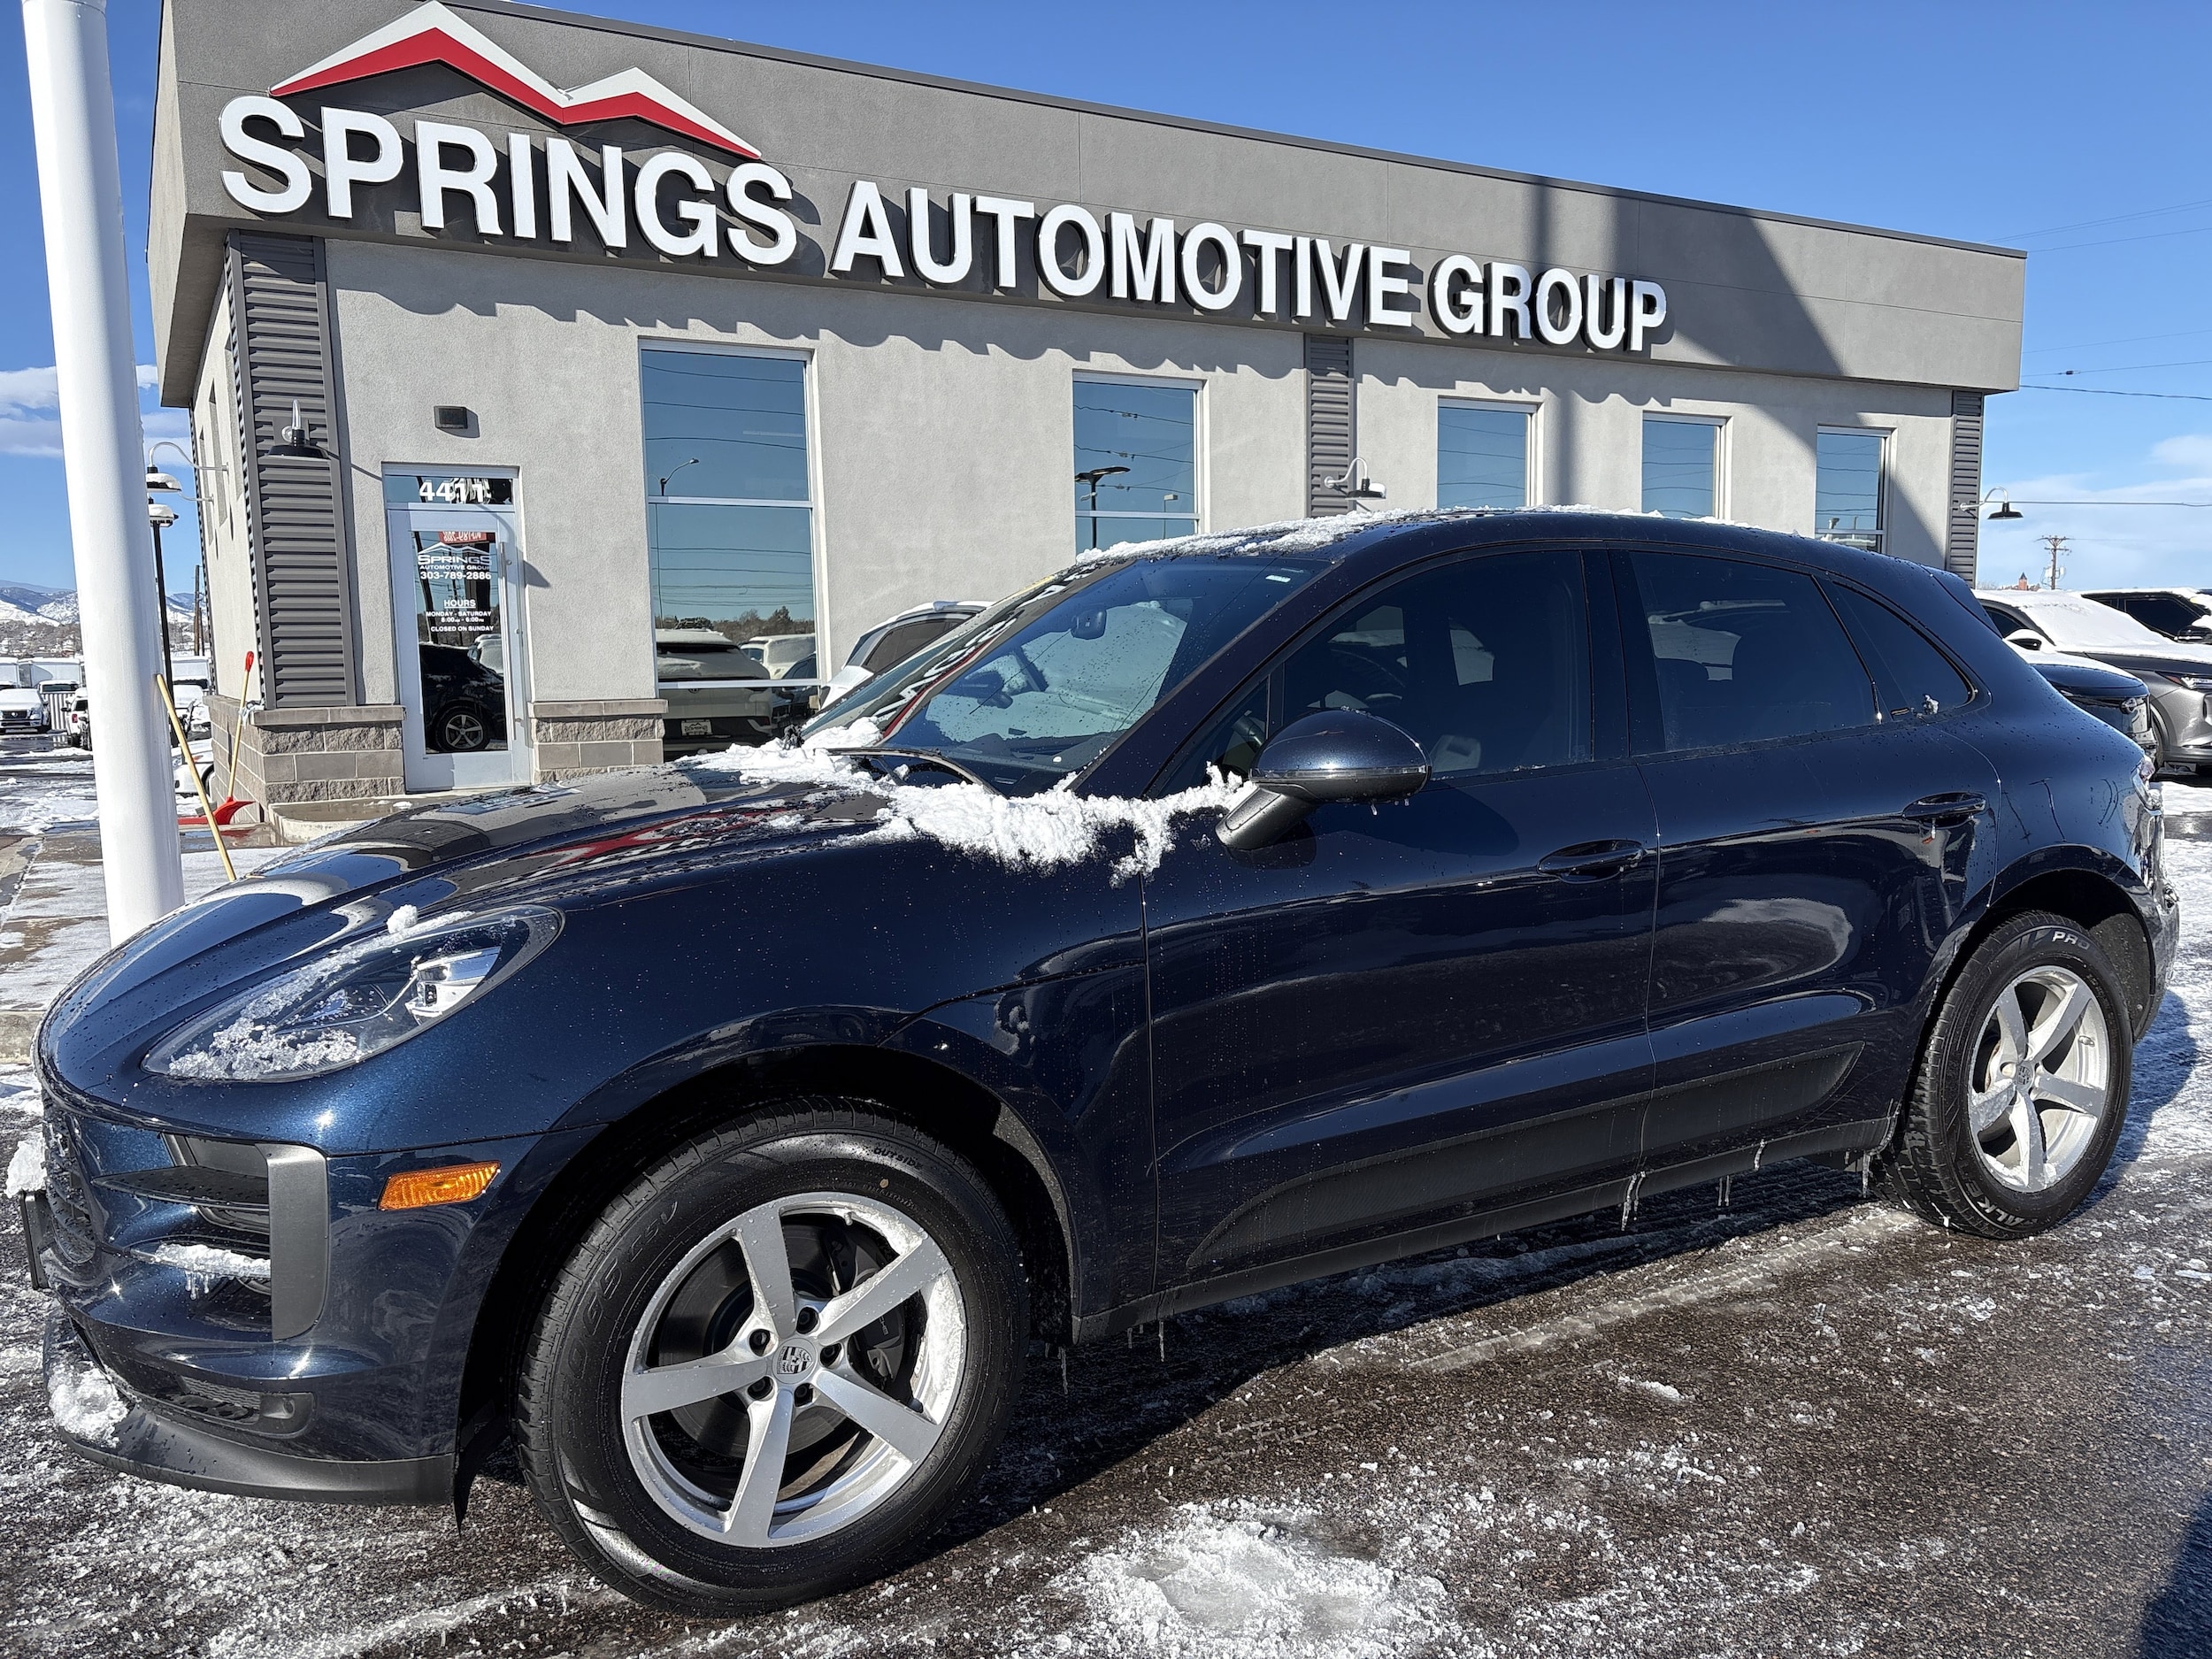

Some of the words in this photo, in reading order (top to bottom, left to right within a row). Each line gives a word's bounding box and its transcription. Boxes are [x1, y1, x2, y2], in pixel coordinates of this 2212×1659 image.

[219, 95, 797, 267] SPRINGS
[830, 180, 1417, 326] AUTOMOTIVE
[1431, 254, 1668, 353] GROUP
[419, 480, 484, 503] 4411
[418, 555, 492, 565] SPRINGS
[420, 571, 492, 580] 303-789-2886
[2051, 931, 2090, 950] PRO
